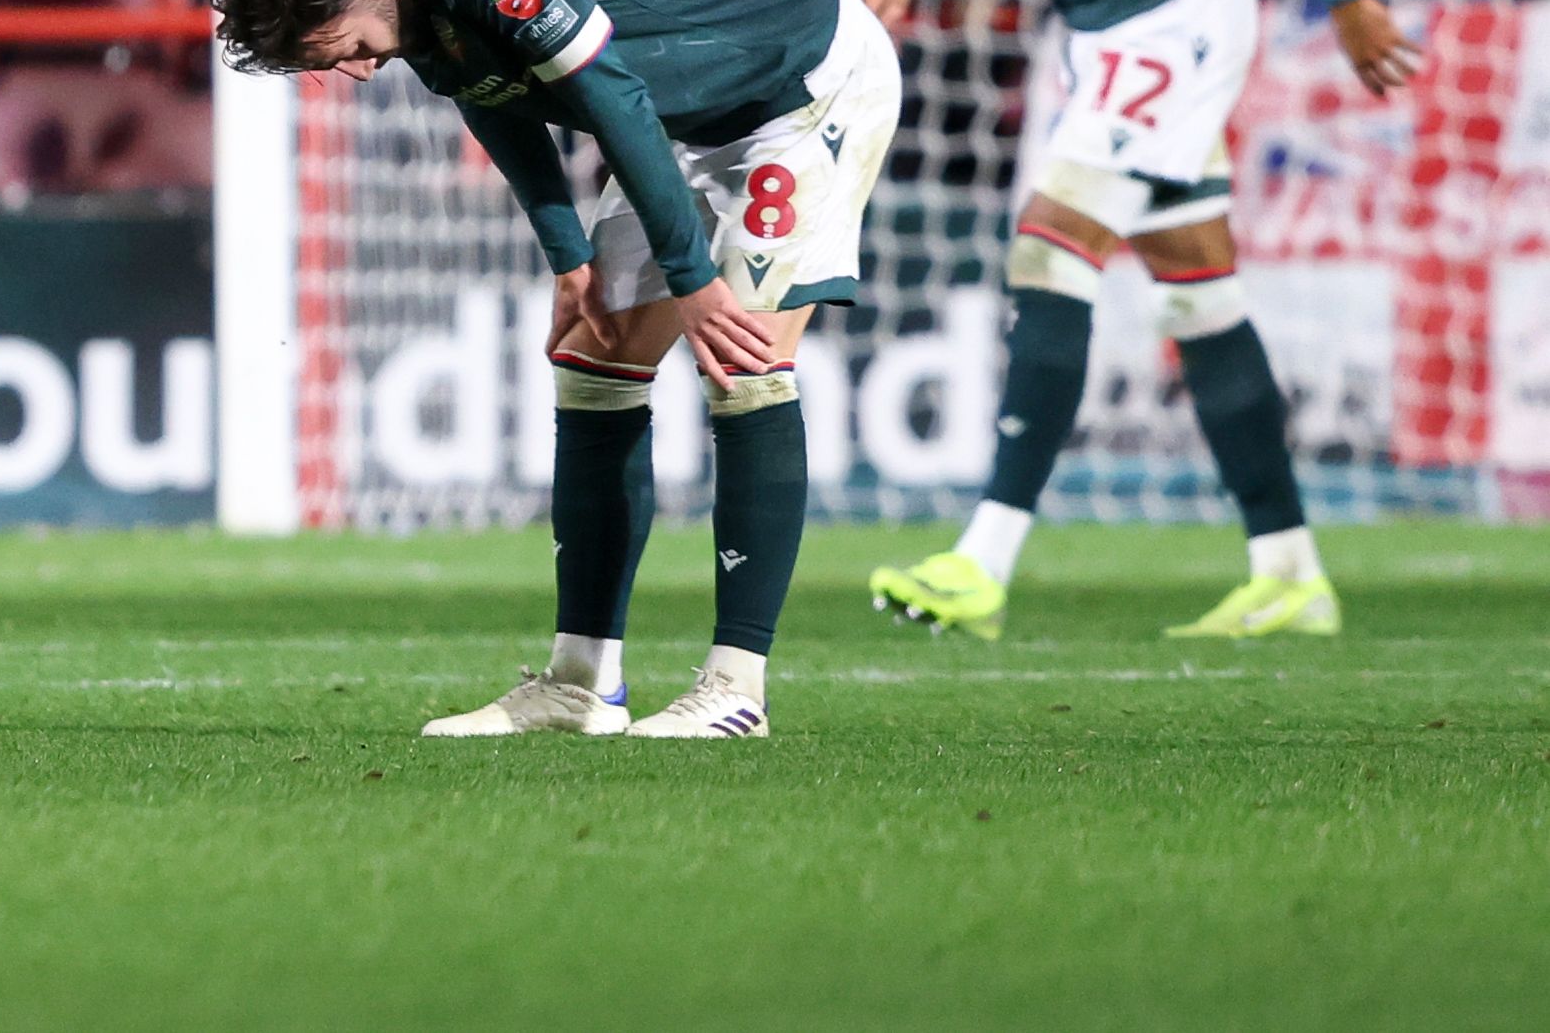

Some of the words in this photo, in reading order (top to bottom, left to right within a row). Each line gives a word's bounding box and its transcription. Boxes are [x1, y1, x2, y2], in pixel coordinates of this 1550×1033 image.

[530, 6, 565, 39] whites
[1097, 51, 1172, 130] 12
[743, 162, 797, 239] 8
